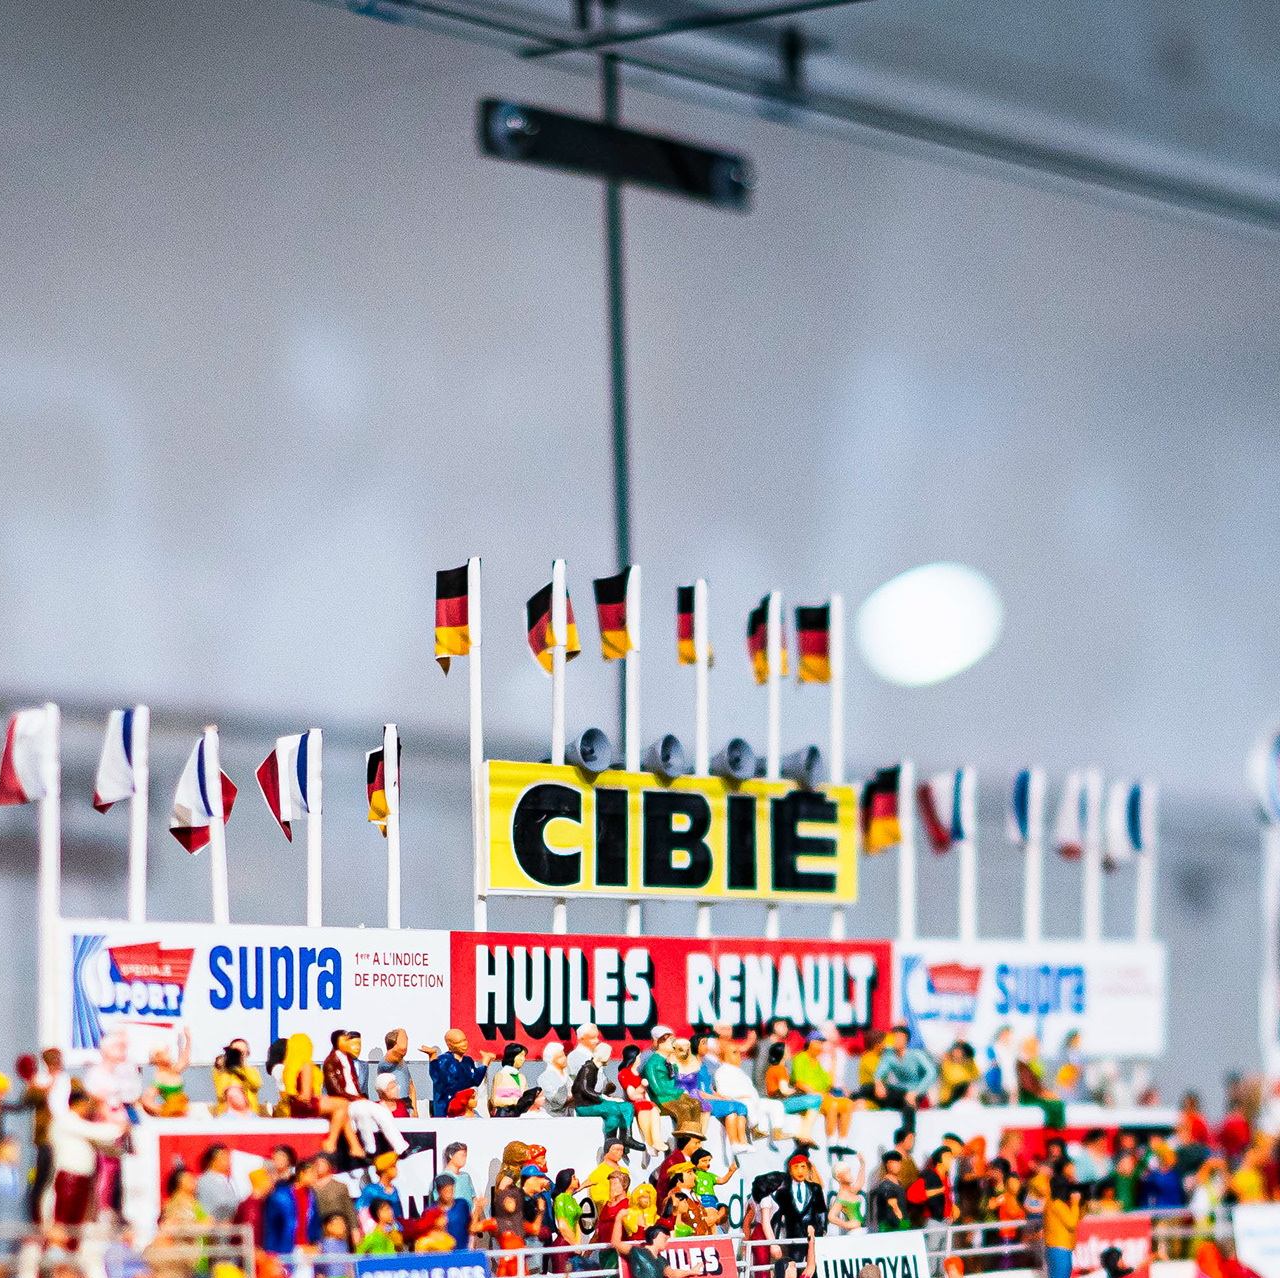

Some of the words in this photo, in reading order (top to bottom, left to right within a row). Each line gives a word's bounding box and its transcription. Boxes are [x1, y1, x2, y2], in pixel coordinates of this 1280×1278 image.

[354, 972, 370, 987] DE
[372, 973, 444, 988] PROTECTION
[372, 951, 381, 966] A
[383, 952, 430, 967] L'INDICE
[208, 944, 343, 1045] supra
[474, 944, 654, 1030] HUILES
[685, 952, 879, 1032] RENAULT
[660, 1246, 721, 1275] ILES
